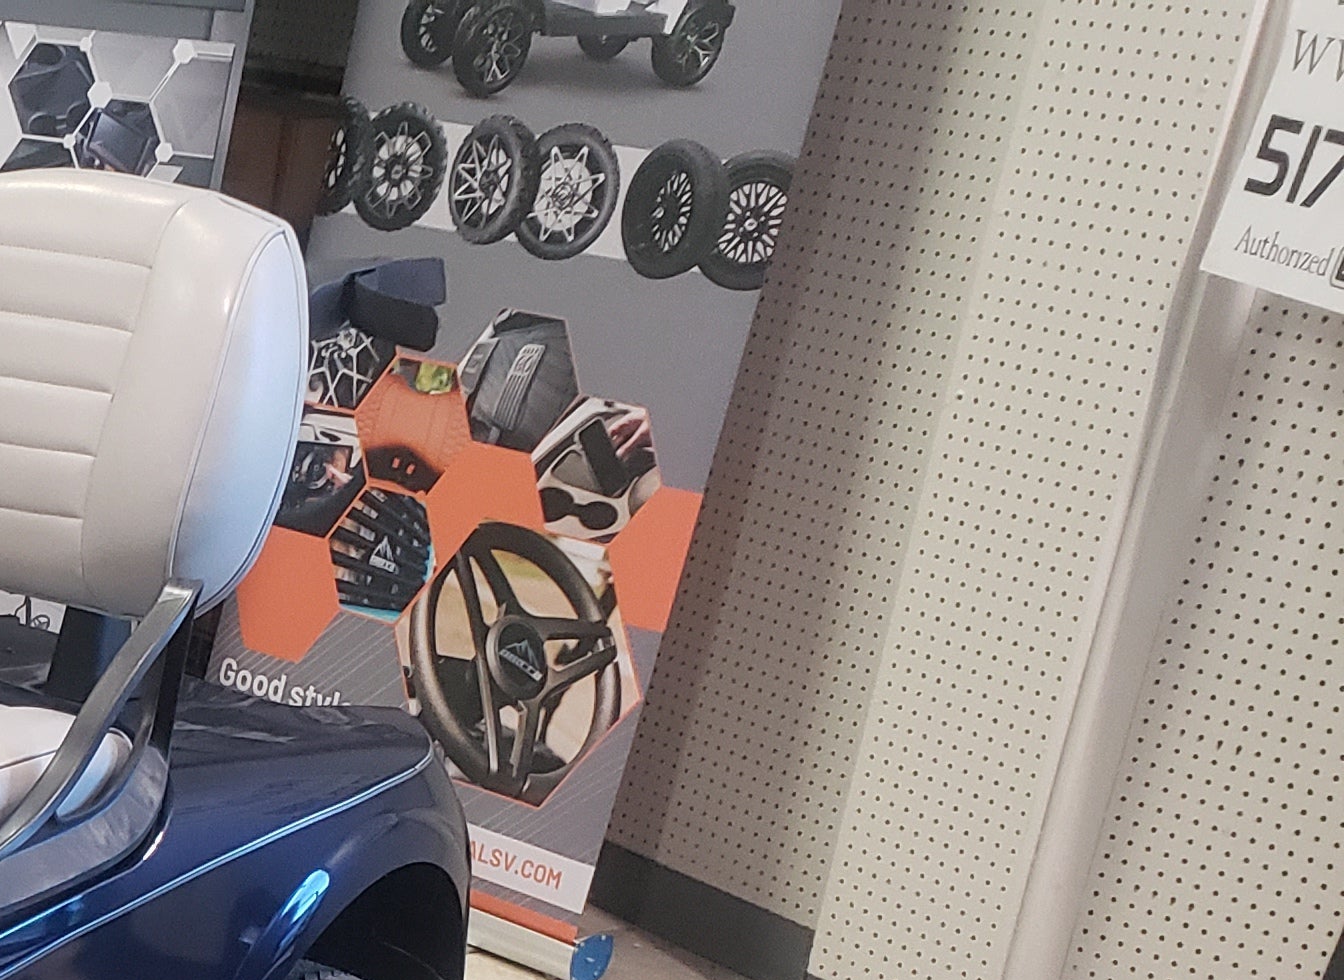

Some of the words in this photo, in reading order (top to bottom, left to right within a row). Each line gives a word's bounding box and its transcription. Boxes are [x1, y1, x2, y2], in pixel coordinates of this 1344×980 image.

[1234, 226, 1334, 276] Authorized
[219, 657, 287, 703] Good
[288, 685, 351, 706] styl
